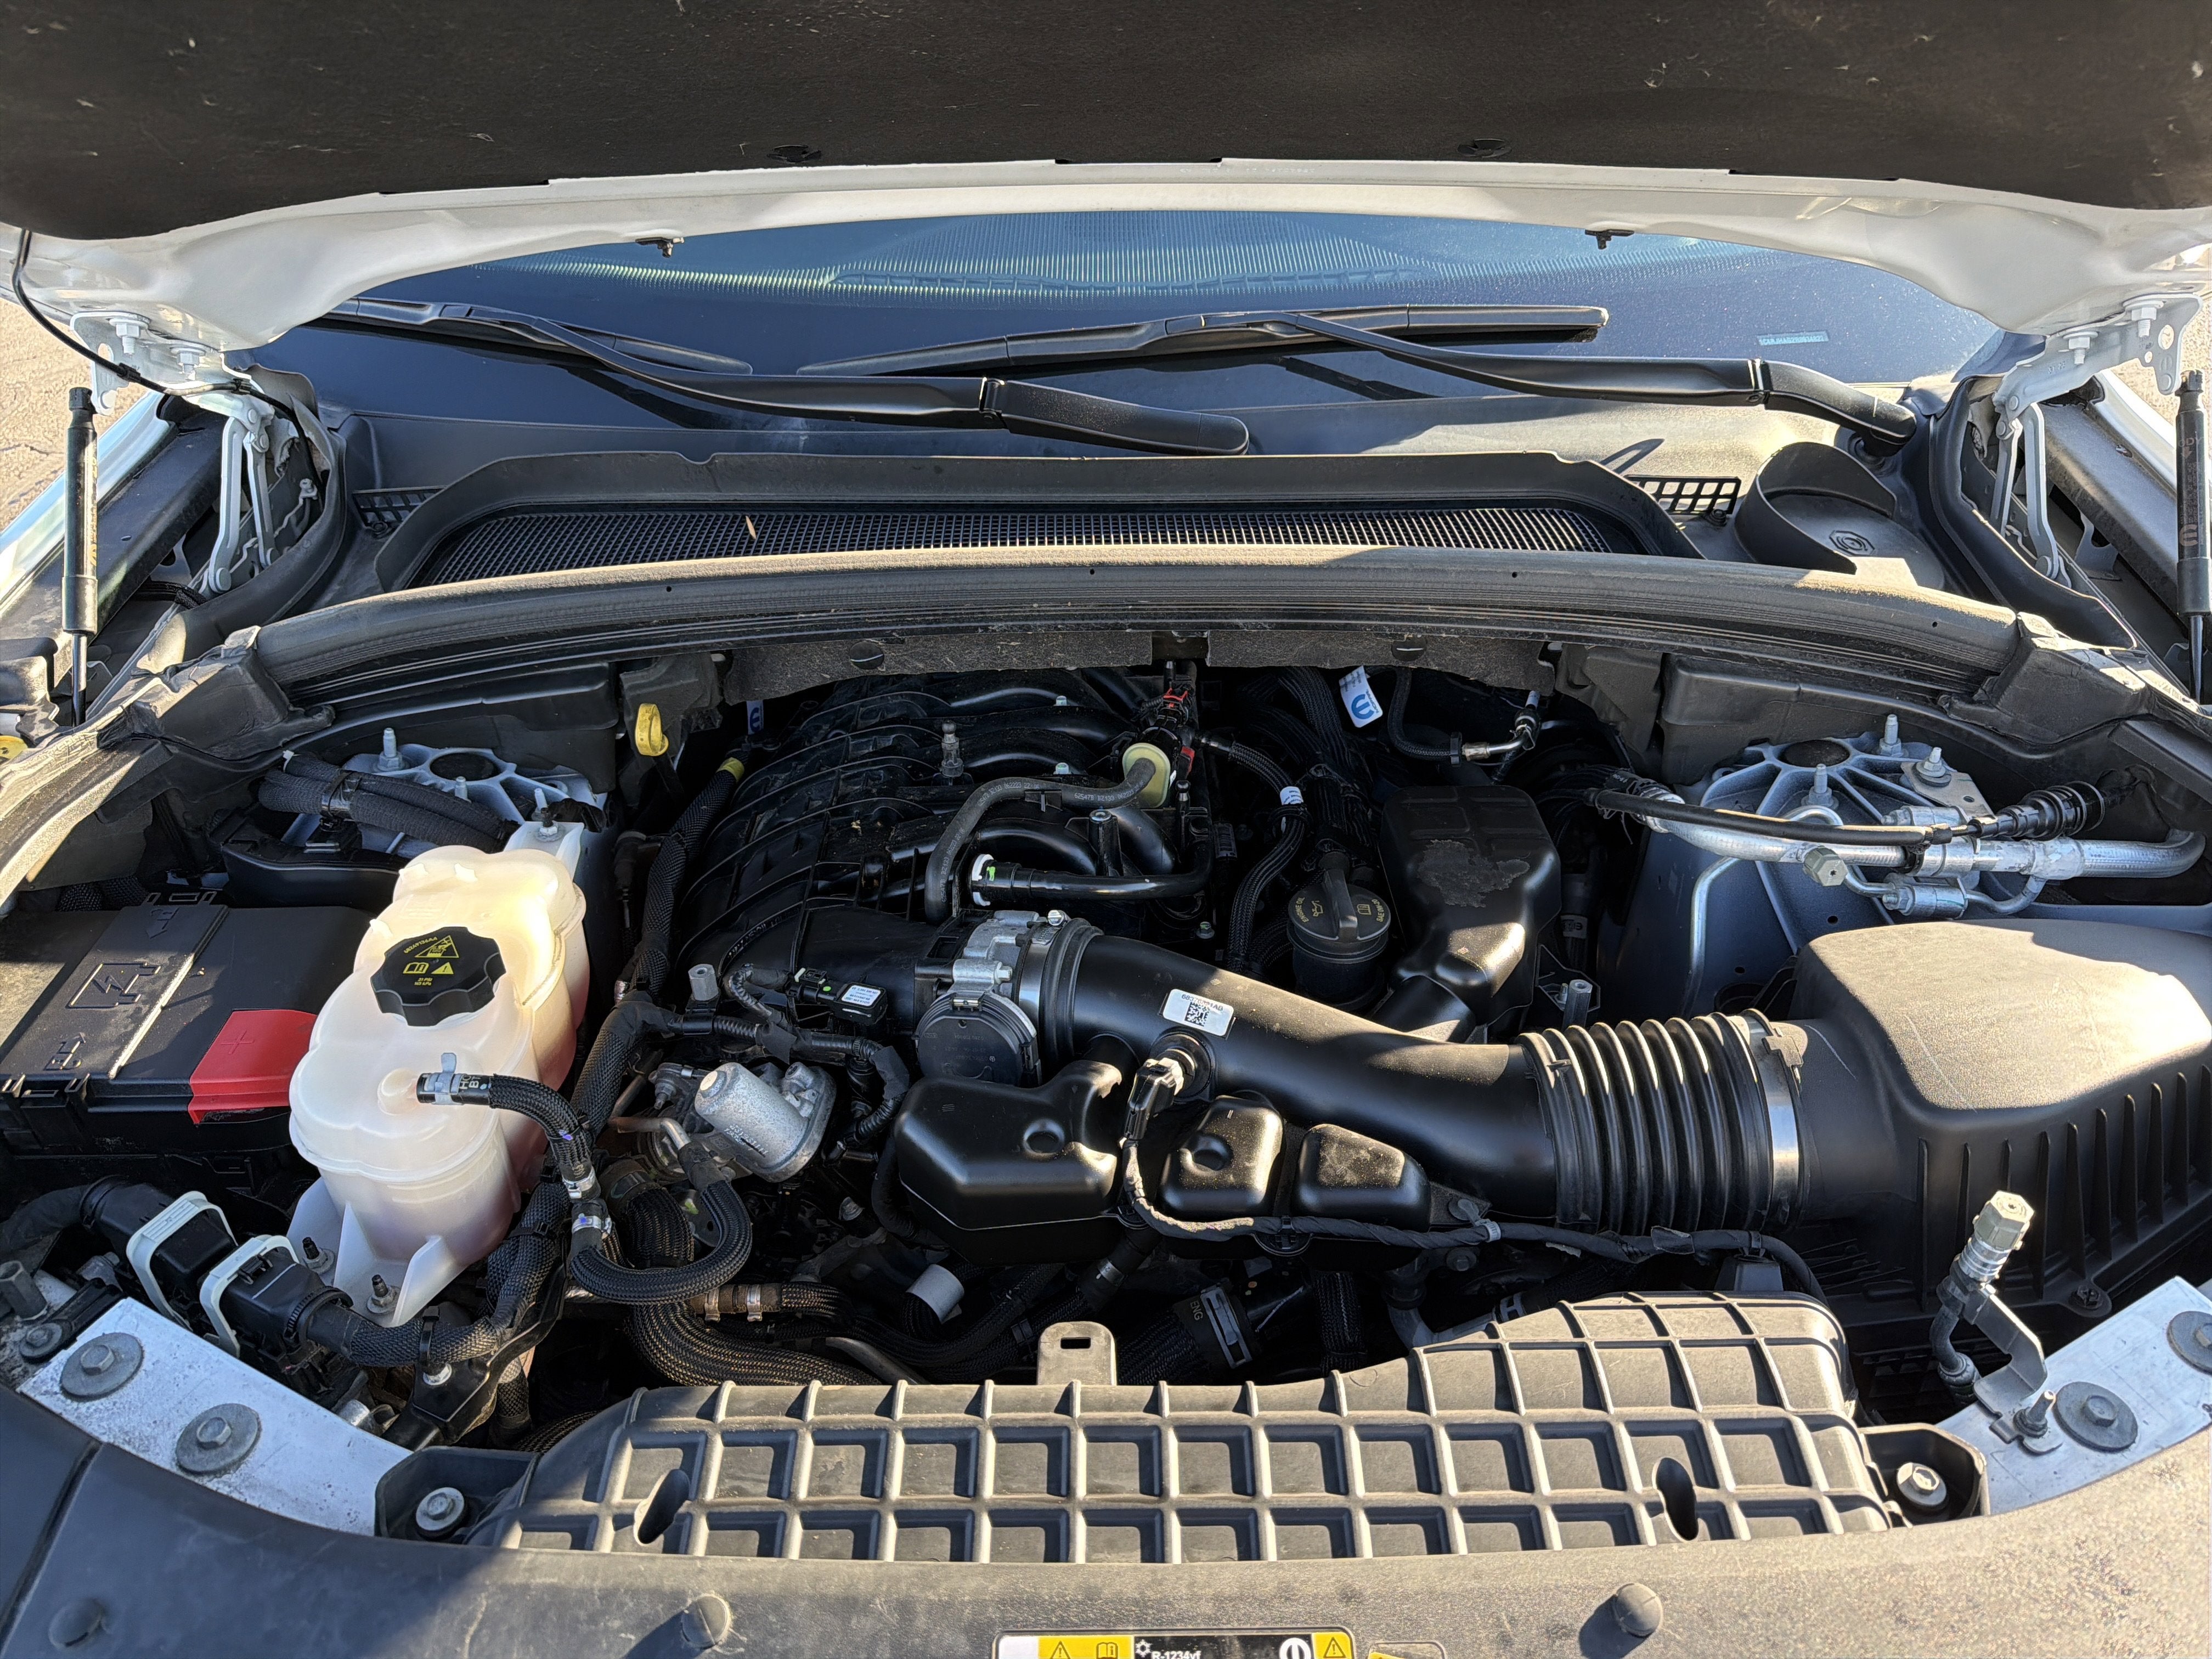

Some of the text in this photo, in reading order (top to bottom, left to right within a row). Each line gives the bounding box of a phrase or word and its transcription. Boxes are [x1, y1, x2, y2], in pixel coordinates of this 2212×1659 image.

[1295, 896, 1310, 923] ENGINE OIL
[1372, 899, 1385, 922] SAE 0W-20
[1190, 1300, 1203, 1321] ENG
